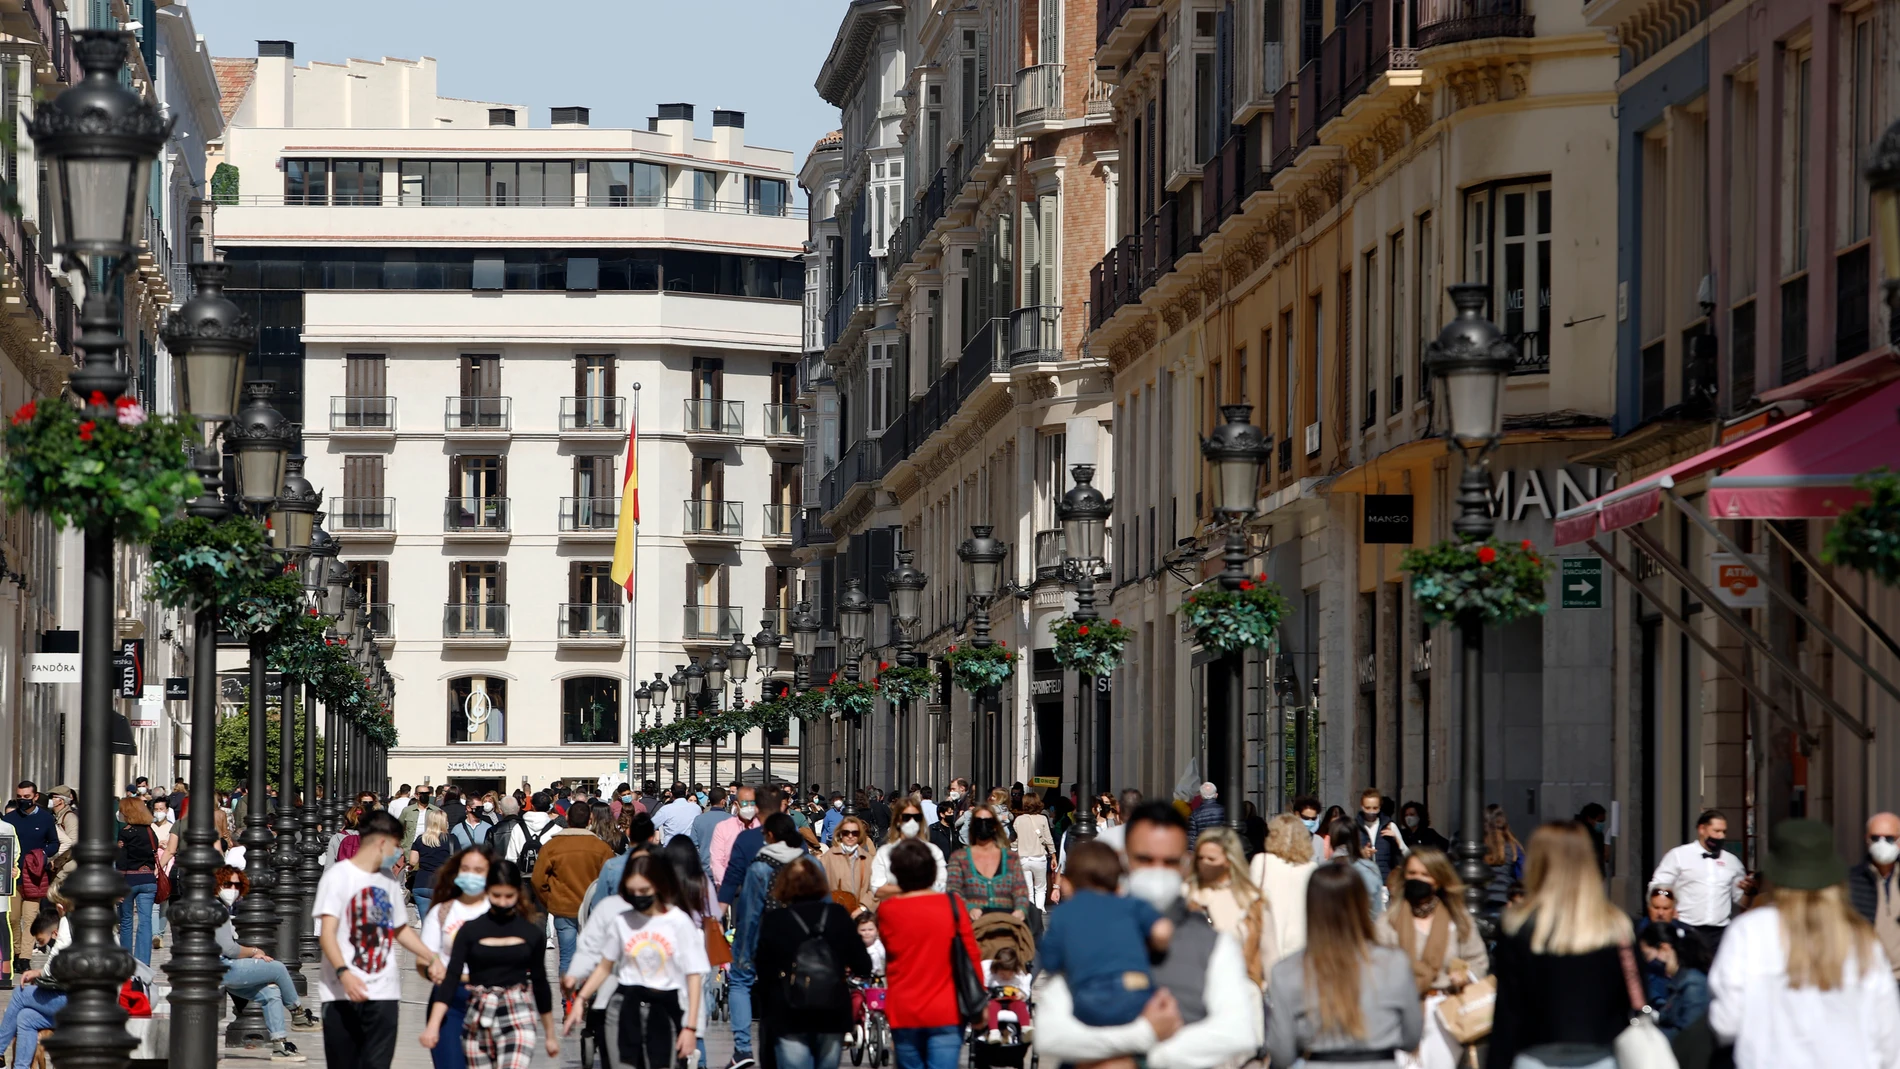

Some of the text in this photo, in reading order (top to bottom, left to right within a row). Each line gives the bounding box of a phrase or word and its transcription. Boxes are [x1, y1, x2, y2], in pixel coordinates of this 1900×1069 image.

[1368, 515, 1409, 523] MANGO
[1724, 567, 1754, 577] ATM
[1031, 680, 1061, 695] SPRINGFIELD
[447, 760, 506, 771] stradivarius
